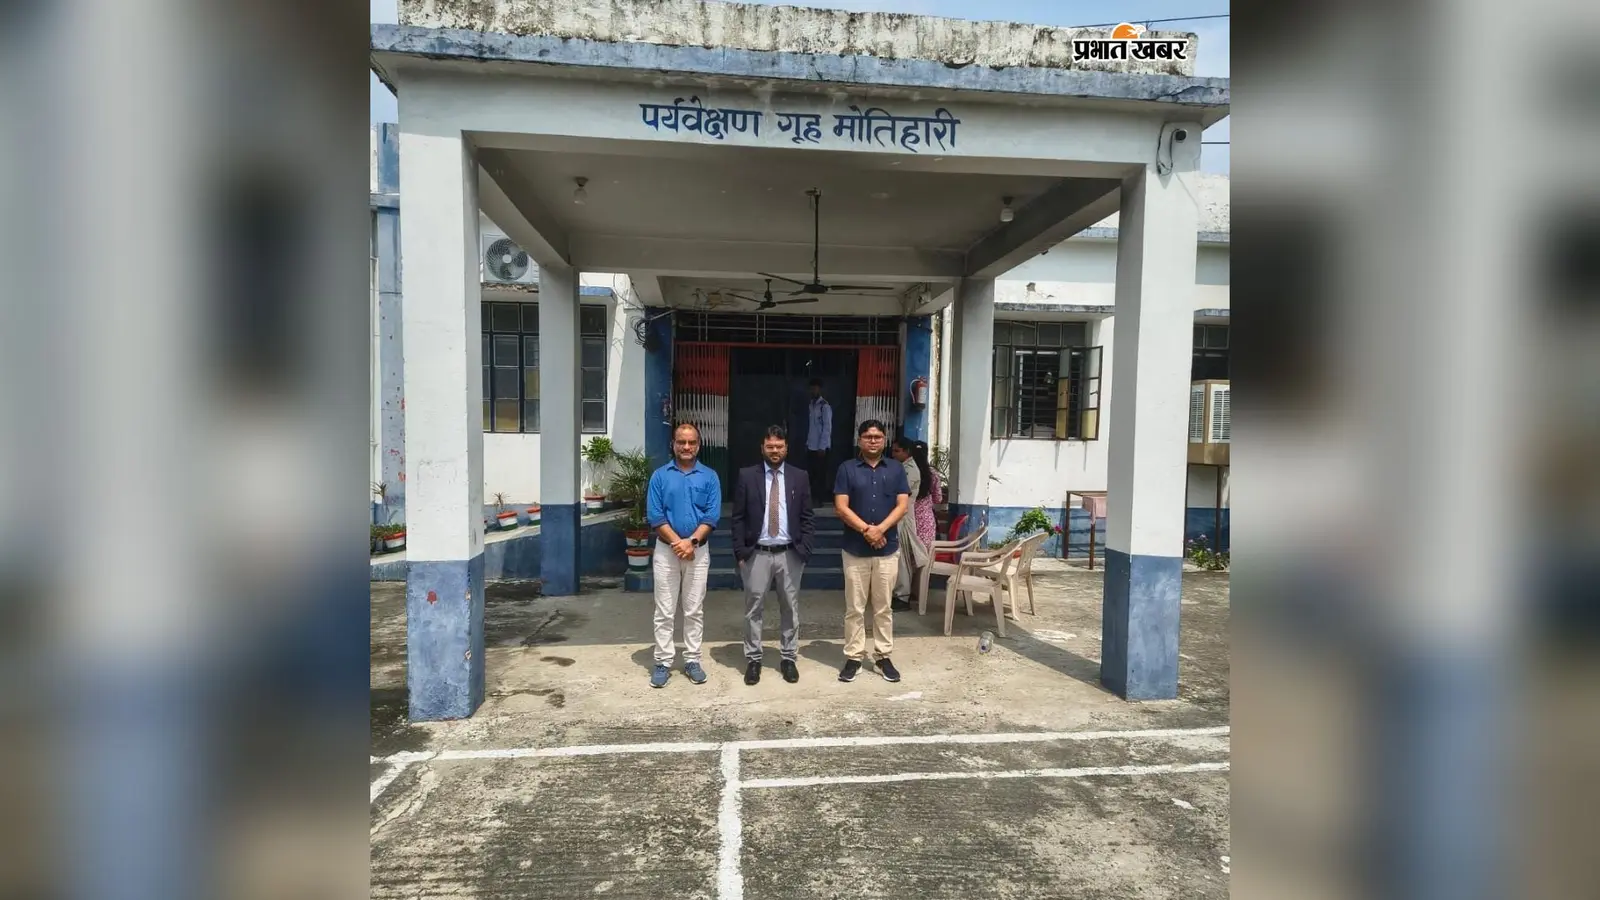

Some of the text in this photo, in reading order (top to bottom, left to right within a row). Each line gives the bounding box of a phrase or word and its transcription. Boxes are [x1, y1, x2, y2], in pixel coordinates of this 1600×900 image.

[639, 96, 961, 153] पर्यवेक्षण गृह मोतिहारी
